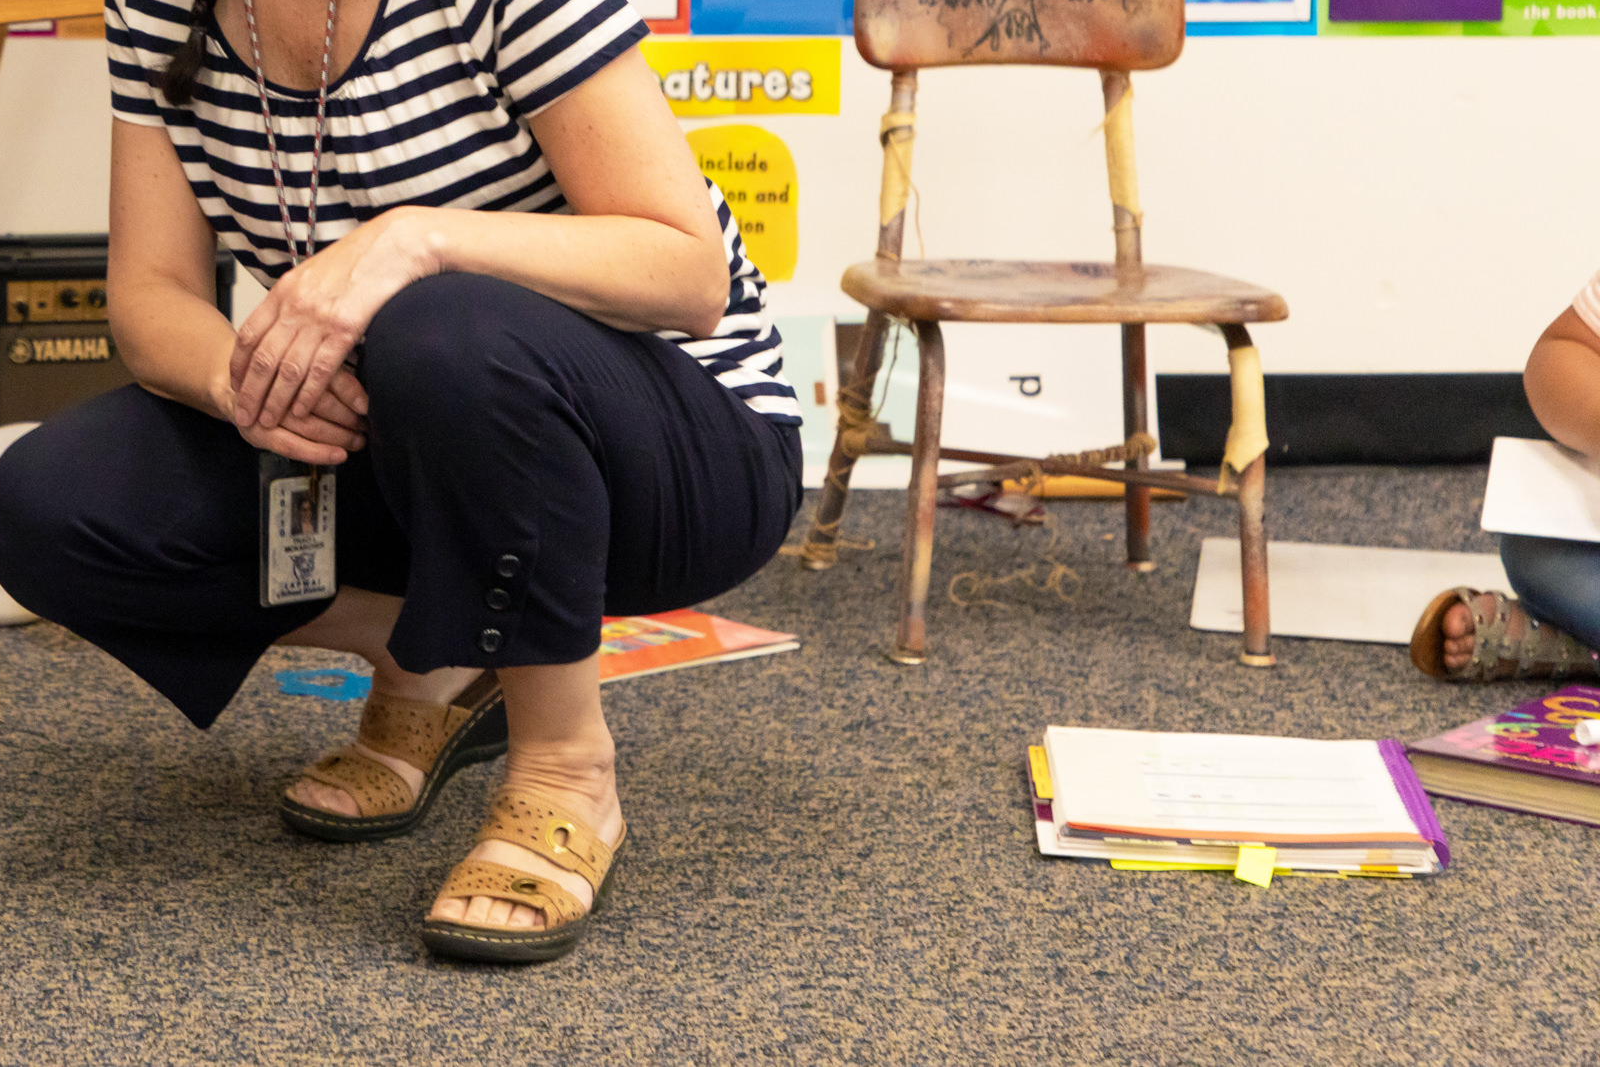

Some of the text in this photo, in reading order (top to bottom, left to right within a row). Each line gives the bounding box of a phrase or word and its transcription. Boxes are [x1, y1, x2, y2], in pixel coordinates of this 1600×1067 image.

[700, 152, 768, 171] include
[756, 184, 790, 203] and
[33, 338, 109, 361] YAMAHA
